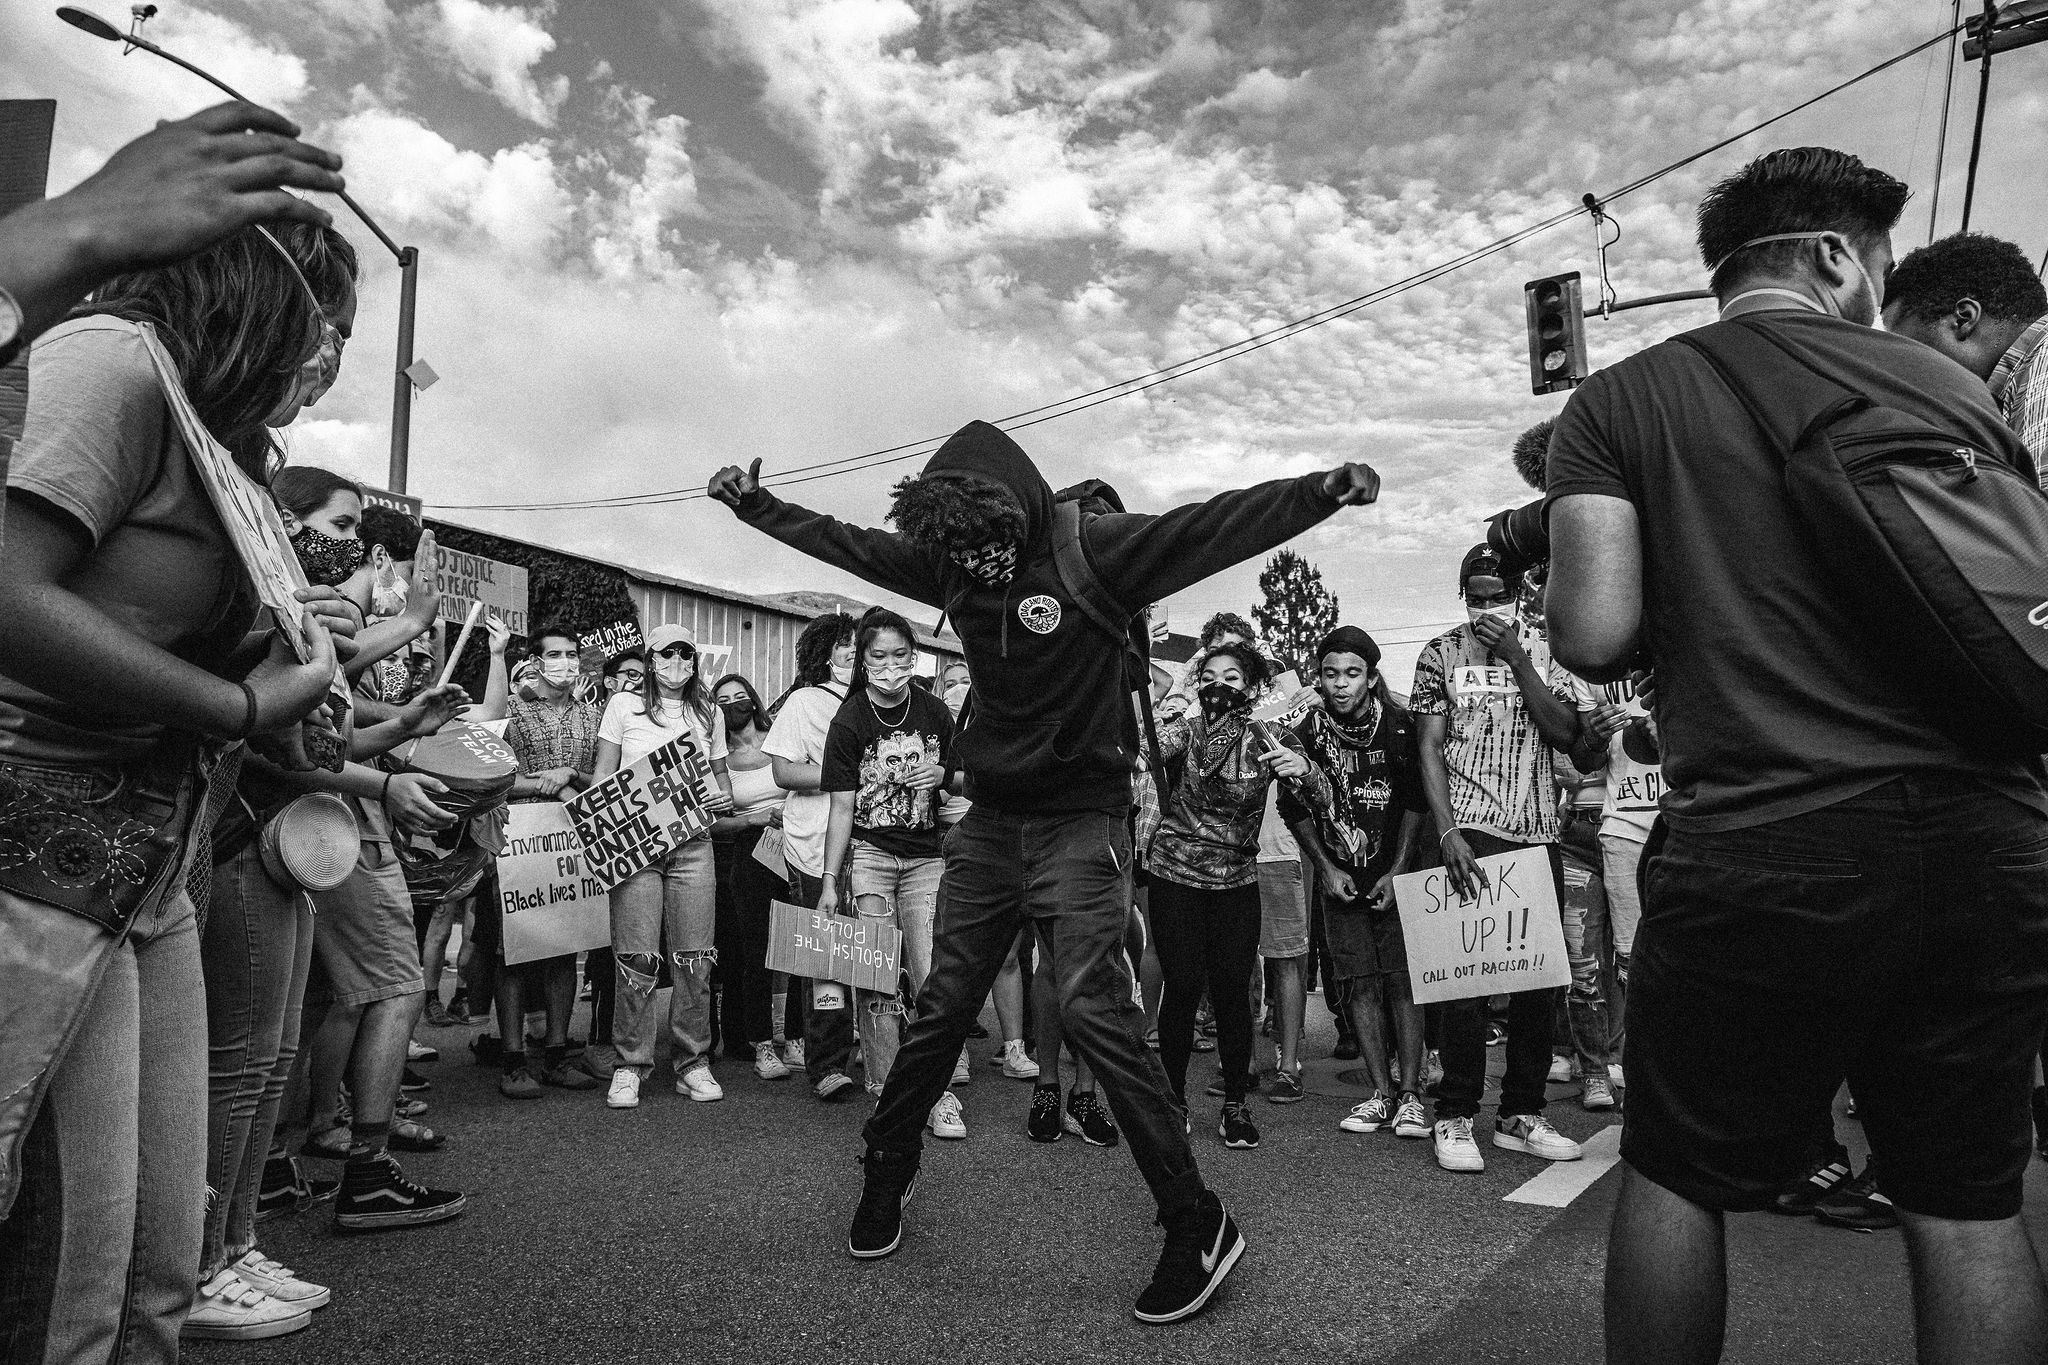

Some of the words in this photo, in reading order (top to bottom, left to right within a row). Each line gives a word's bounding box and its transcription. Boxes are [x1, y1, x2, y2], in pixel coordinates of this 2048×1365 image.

[437, 548, 447, 570] O
[449, 551, 496, 586] JUSTICE,
[437, 573, 445, 593] O
[447, 575, 481, 601] PEACE
[439, 594, 467, 621] FUND
[602, 626, 616, 643] in
[613, 620, 637, 638] the
[616, 633, 643, 651] States
[1462, 669, 1519, 688] AER
[1602, 679, 1637, 705] WU
[1278, 703, 1308, 726] NCE
[457, 733, 498, 764] TEAM
[462, 721, 520, 767] WELCOM
[564, 768, 634, 826] KEEP
[647, 730, 697, 777] HIS
[575, 787, 649, 848] BALLS
[646, 750, 711, 805] BLUE
[1352, 785, 1392, 801] SPIDER-M
[583, 813, 664, 867] UNTIL
[669, 778, 710, 818] HE
[594, 830, 670, 887] VOTES
[666, 806, 718, 847] BLU
[502, 886, 546, 914] Black
[548, 882, 577, 904] lives
[793, 933, 824, 952] THE
[811, 914, 866, 944] POLICE
[833, 941, 895, 972] ABOLISH
[1422, 968, 1449, 984] CALL
[1454, 964, 1476, 979] OUT
